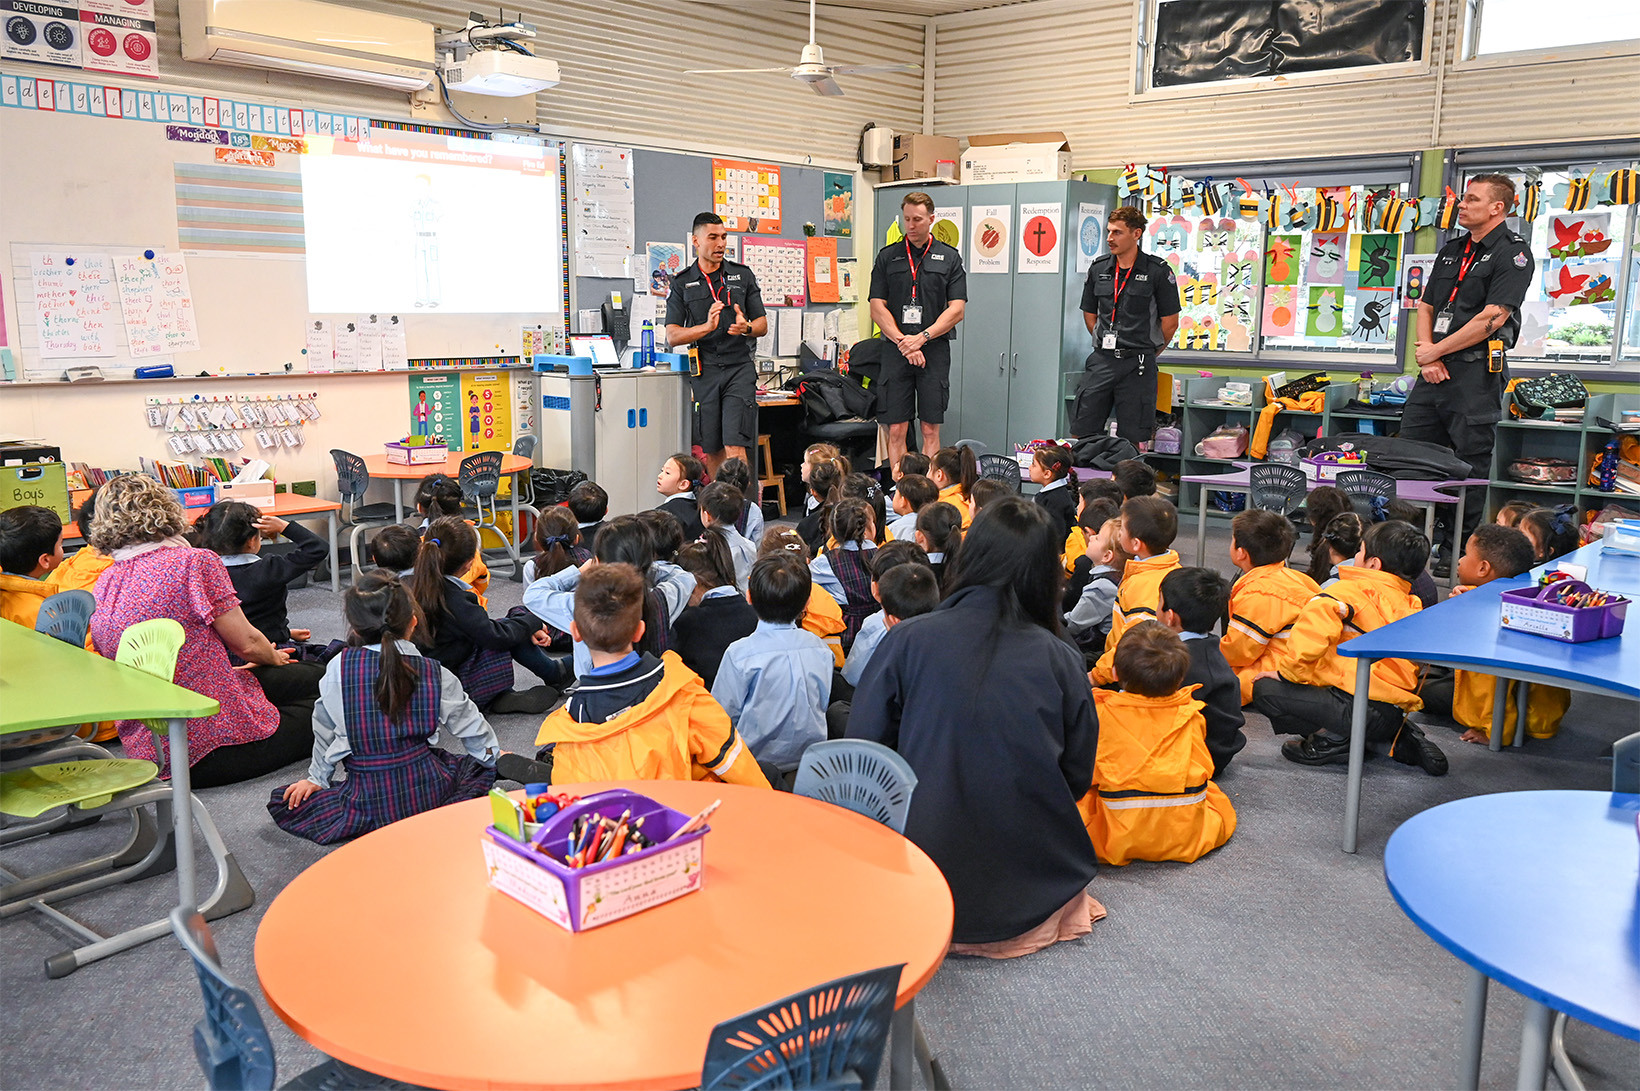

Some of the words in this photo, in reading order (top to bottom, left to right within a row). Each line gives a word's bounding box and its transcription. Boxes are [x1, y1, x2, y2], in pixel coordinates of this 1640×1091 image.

[13, 2, 63, 16] DEVELOPING
[94, 14, 141, 28] MANAGING
[8, 85, 14, 96] c
[22, 81, 33, 97] d
[43, 89, 50, 98] e
[59, 83, 66, 100] f
[78, 93, 85, 108] g
[93, 89, 102, 104] h
[126, 100, 132, 113] j
[143, 95, 150, 110] k
[171, 103, 186, 113] m
[191, 105, 201, 115] n
[208, 107, 215, 115] o
[222, 108, 231, 121] p
[237, 111, 245, 126] q
[250, 112, 258, 122] r
[293, 119, 300, 127] u
[307, 118, 314, 127] v
[320, 121, 330, 129] w
[334, 123, 342, 132] x
[351, 124, 357, 137] y
[179, 128, 220, 141] Monday
[272, 140, 294, 150] May
[356, 142, 383, 154] What
[385, 144, 408, 156] have
[410, 148, 428, 159] you
[430, 150, 493, 164] remembered?
[523, 160, 536, 169] Fire
[537, 161, 545, 169] Ed
[1022, 207, 1060, 216] Redemption
[43, 255, 53, 265] th
[122, 259, 136, 270] sh
[120, 274, 145, 285] sheep
[86, 293, 105, 302] this
[38, 299, 66, 310] father
[81, 332, 100, 341] with
[44, 340, 77, 351] Thursday
[1524, 621, 1548, 630] Arielle
[624, 890, 656, 904] Anna
